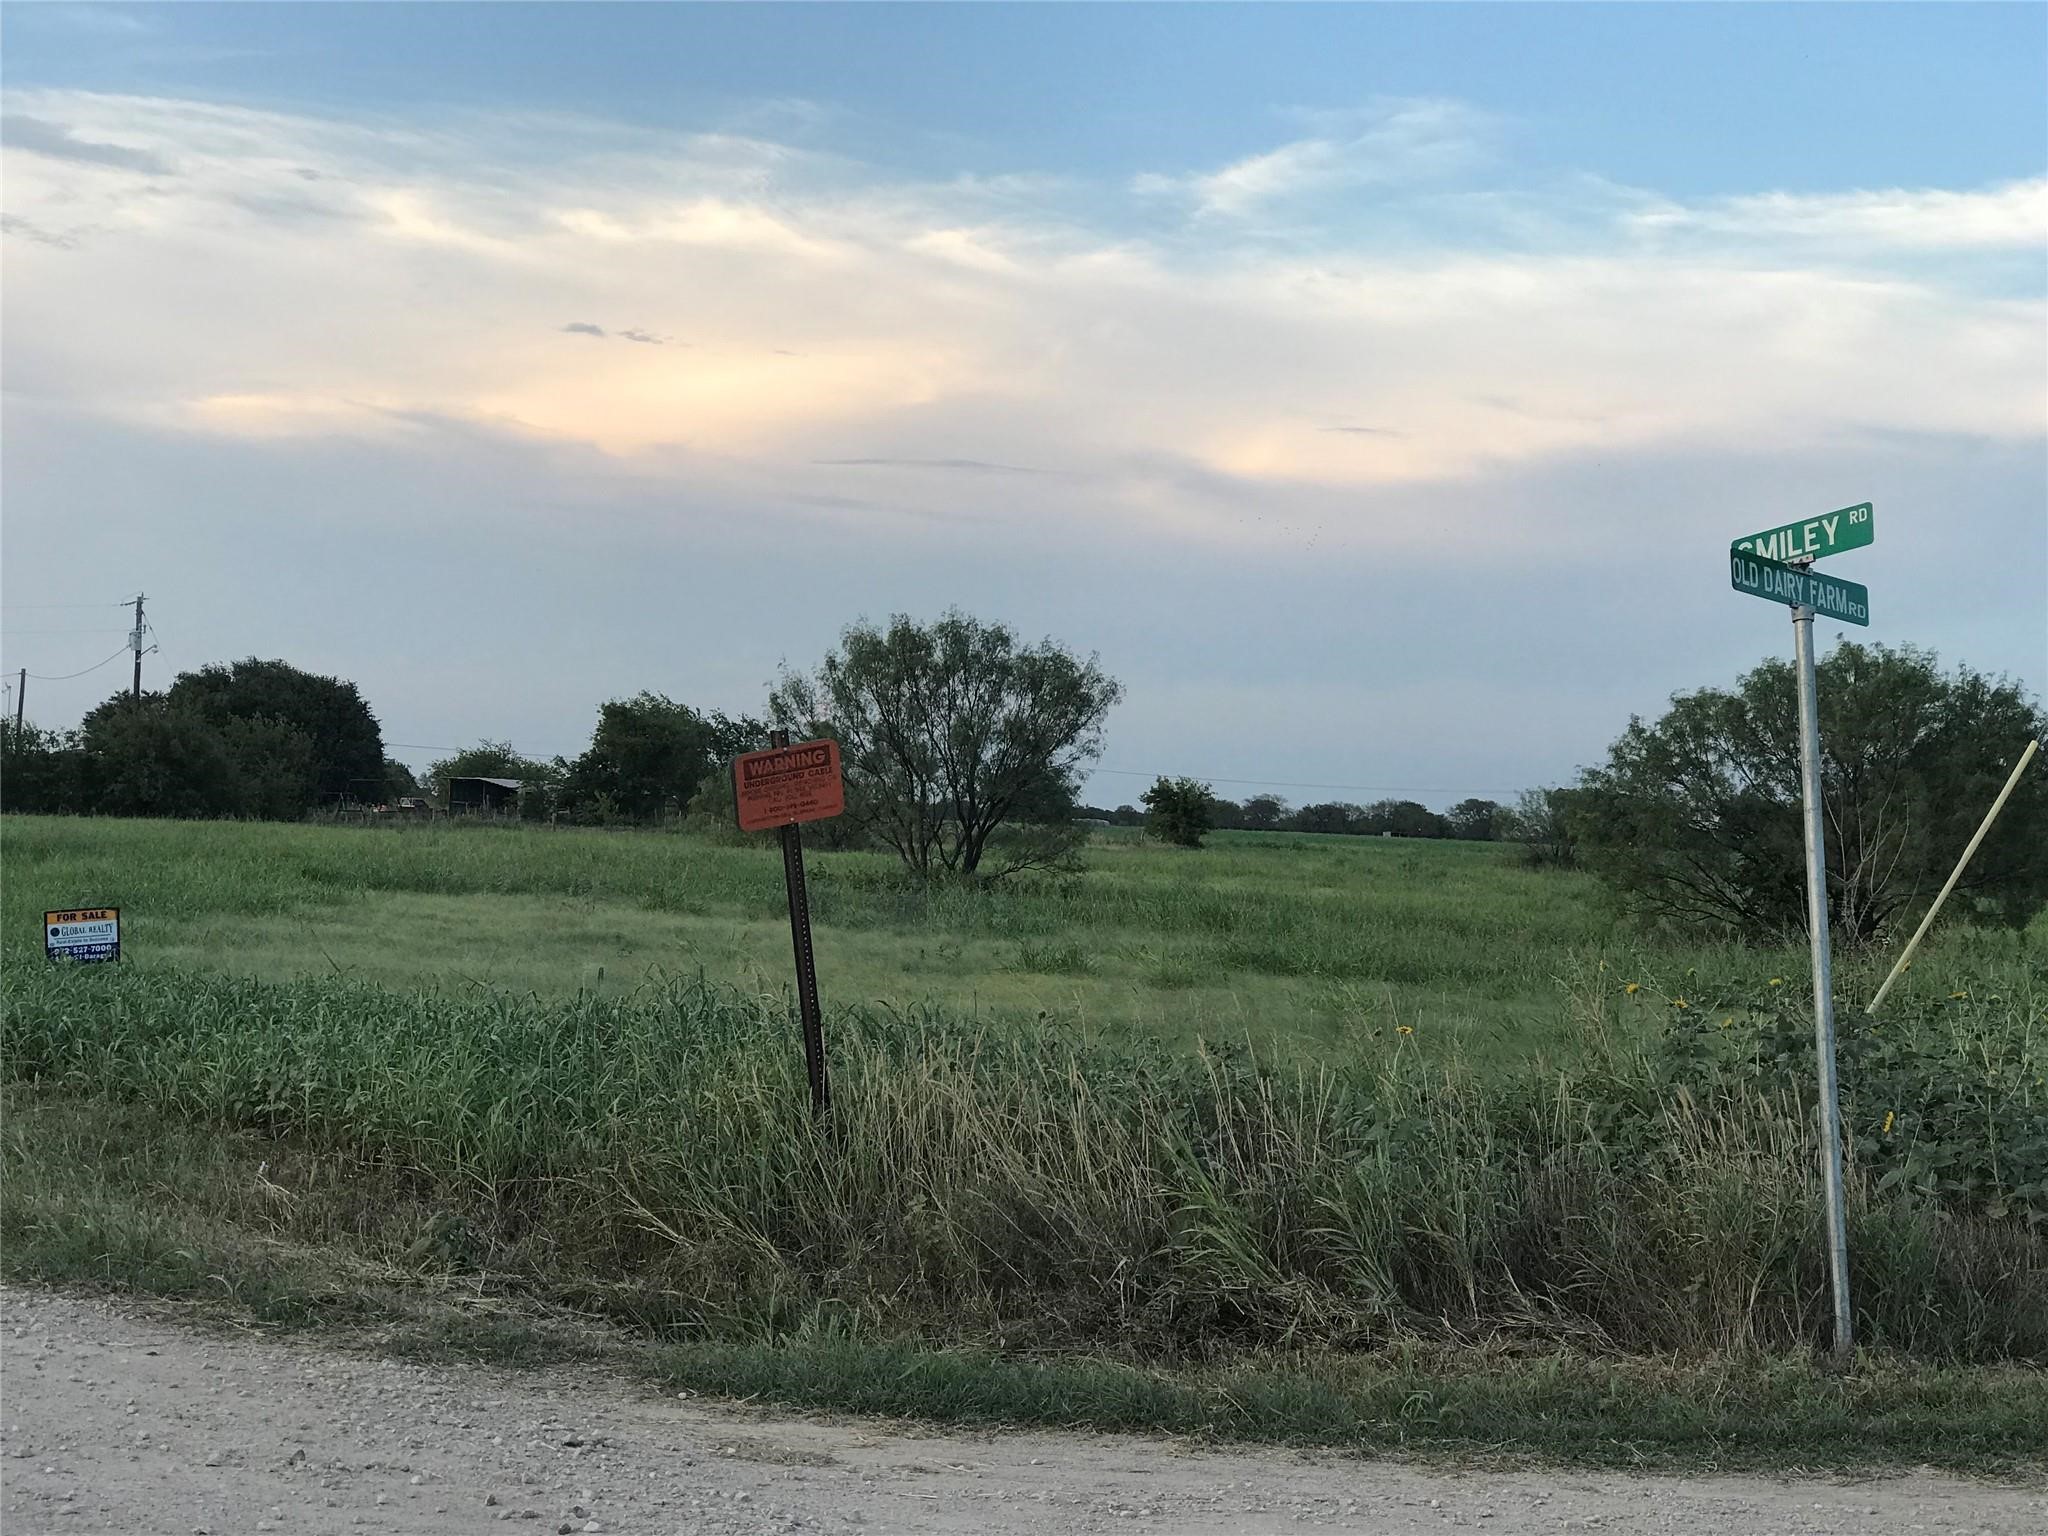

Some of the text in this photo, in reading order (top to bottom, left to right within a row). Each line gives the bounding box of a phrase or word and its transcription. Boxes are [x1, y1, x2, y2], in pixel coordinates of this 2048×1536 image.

[1849, 507, 1868, 525] RD
[1732, 557, 1866, 619] OLD DAIRY FARM RD
[749, 749, 826, 777] WARNING
[744, 772, 805, 789] UNDERGROUND
[56, 910, 108, 922] FOR SALE
[61, 923, 113, 936] GLOBAL REALTY
